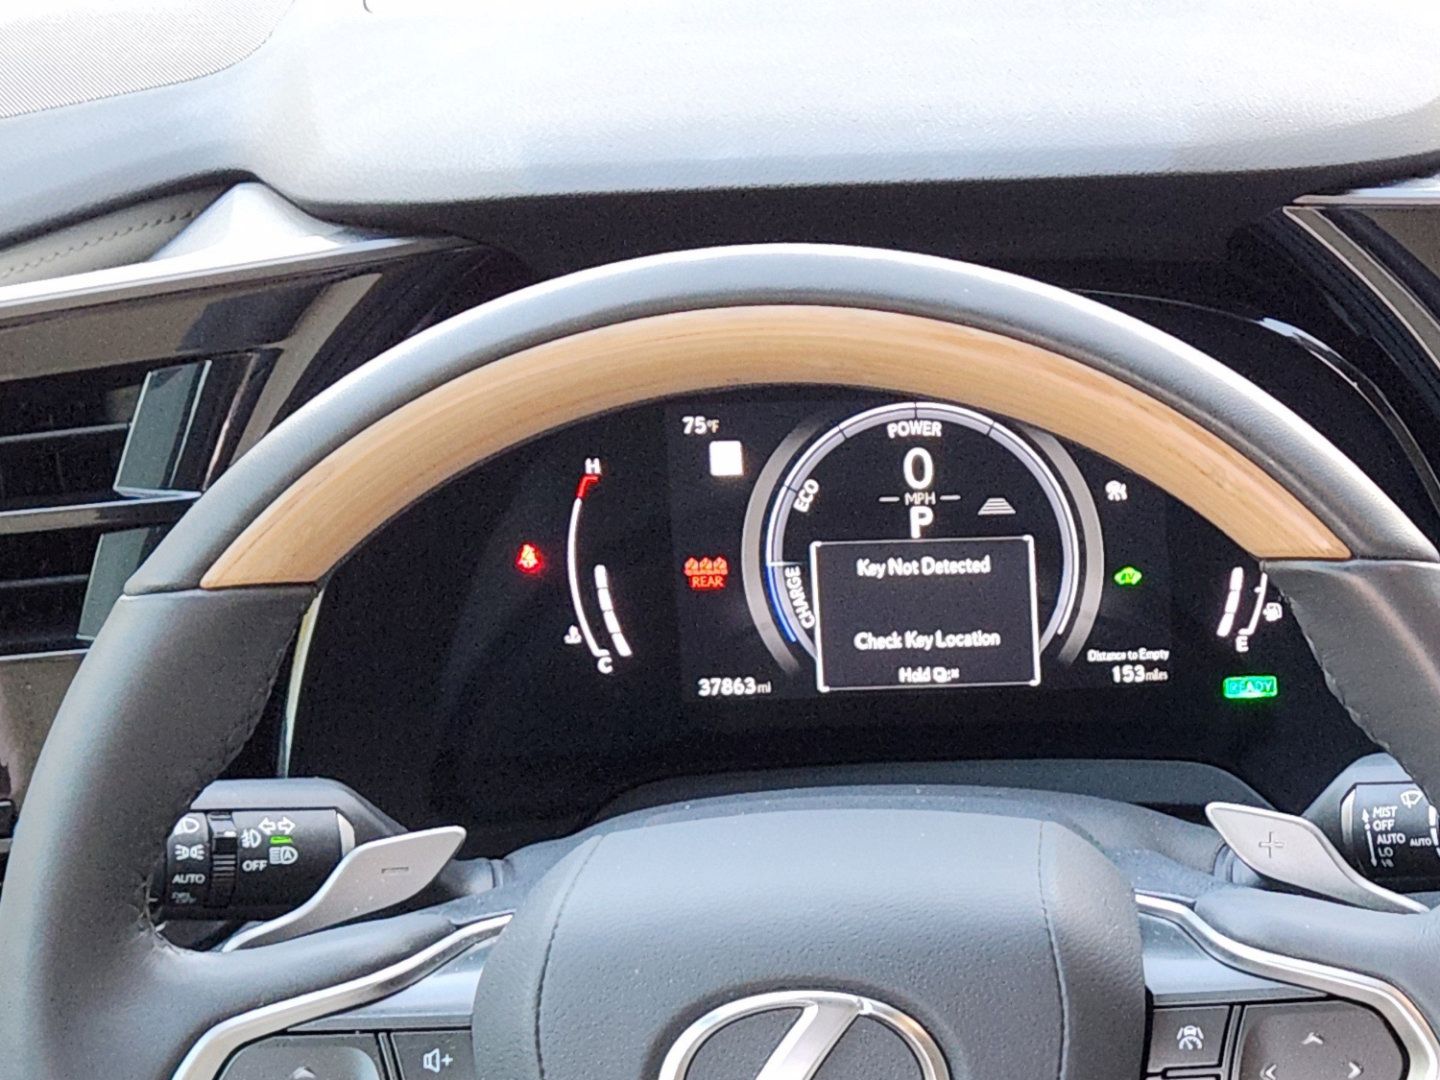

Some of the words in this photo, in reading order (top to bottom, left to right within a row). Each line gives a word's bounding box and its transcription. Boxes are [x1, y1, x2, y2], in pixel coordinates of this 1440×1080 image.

[887, 420, 943, 438] POWER
[585, 458, 601, 474] H
[903, 447, 934, 490] 0
[793, 479, 819, 512] ECO
[904, 491, 936, 506] MPH
[909, 505, 934, 539] P
[856, 558, 886, 579] Key
[887, 557, 919, 576] Not
[921, 554, 991, 576] Detected
[691, 575, 724, 589] REAR
[784, 565, 815, 629] CHARGE
[853, 631, 902, 650] Check
[904, 630, 934, 651] Key
[935, 629, 1001, 648] Location
[1235, 636, 1249, 652] E
[1087, 648, 1126, 662] Distance
[1127, 649, 1138, 661] to
[1138, 647, 1170, 661] Empty
[597, 656, 613, 674] C
[898, 665, 931, 683] Hold
[1229, 679, 1273, 693] READY
[1373, 805, 1398, 818] MIST
[1372, 819, 1395, 832] OFF
[1377, 832, 1406, 845] AUTO
[1410, 837, 1432, 847] AUTO
[1378, 846, 1394, 858] LO
[242, 859, 268, 872] OFF
[171, 873, 206, 884] AUTO
